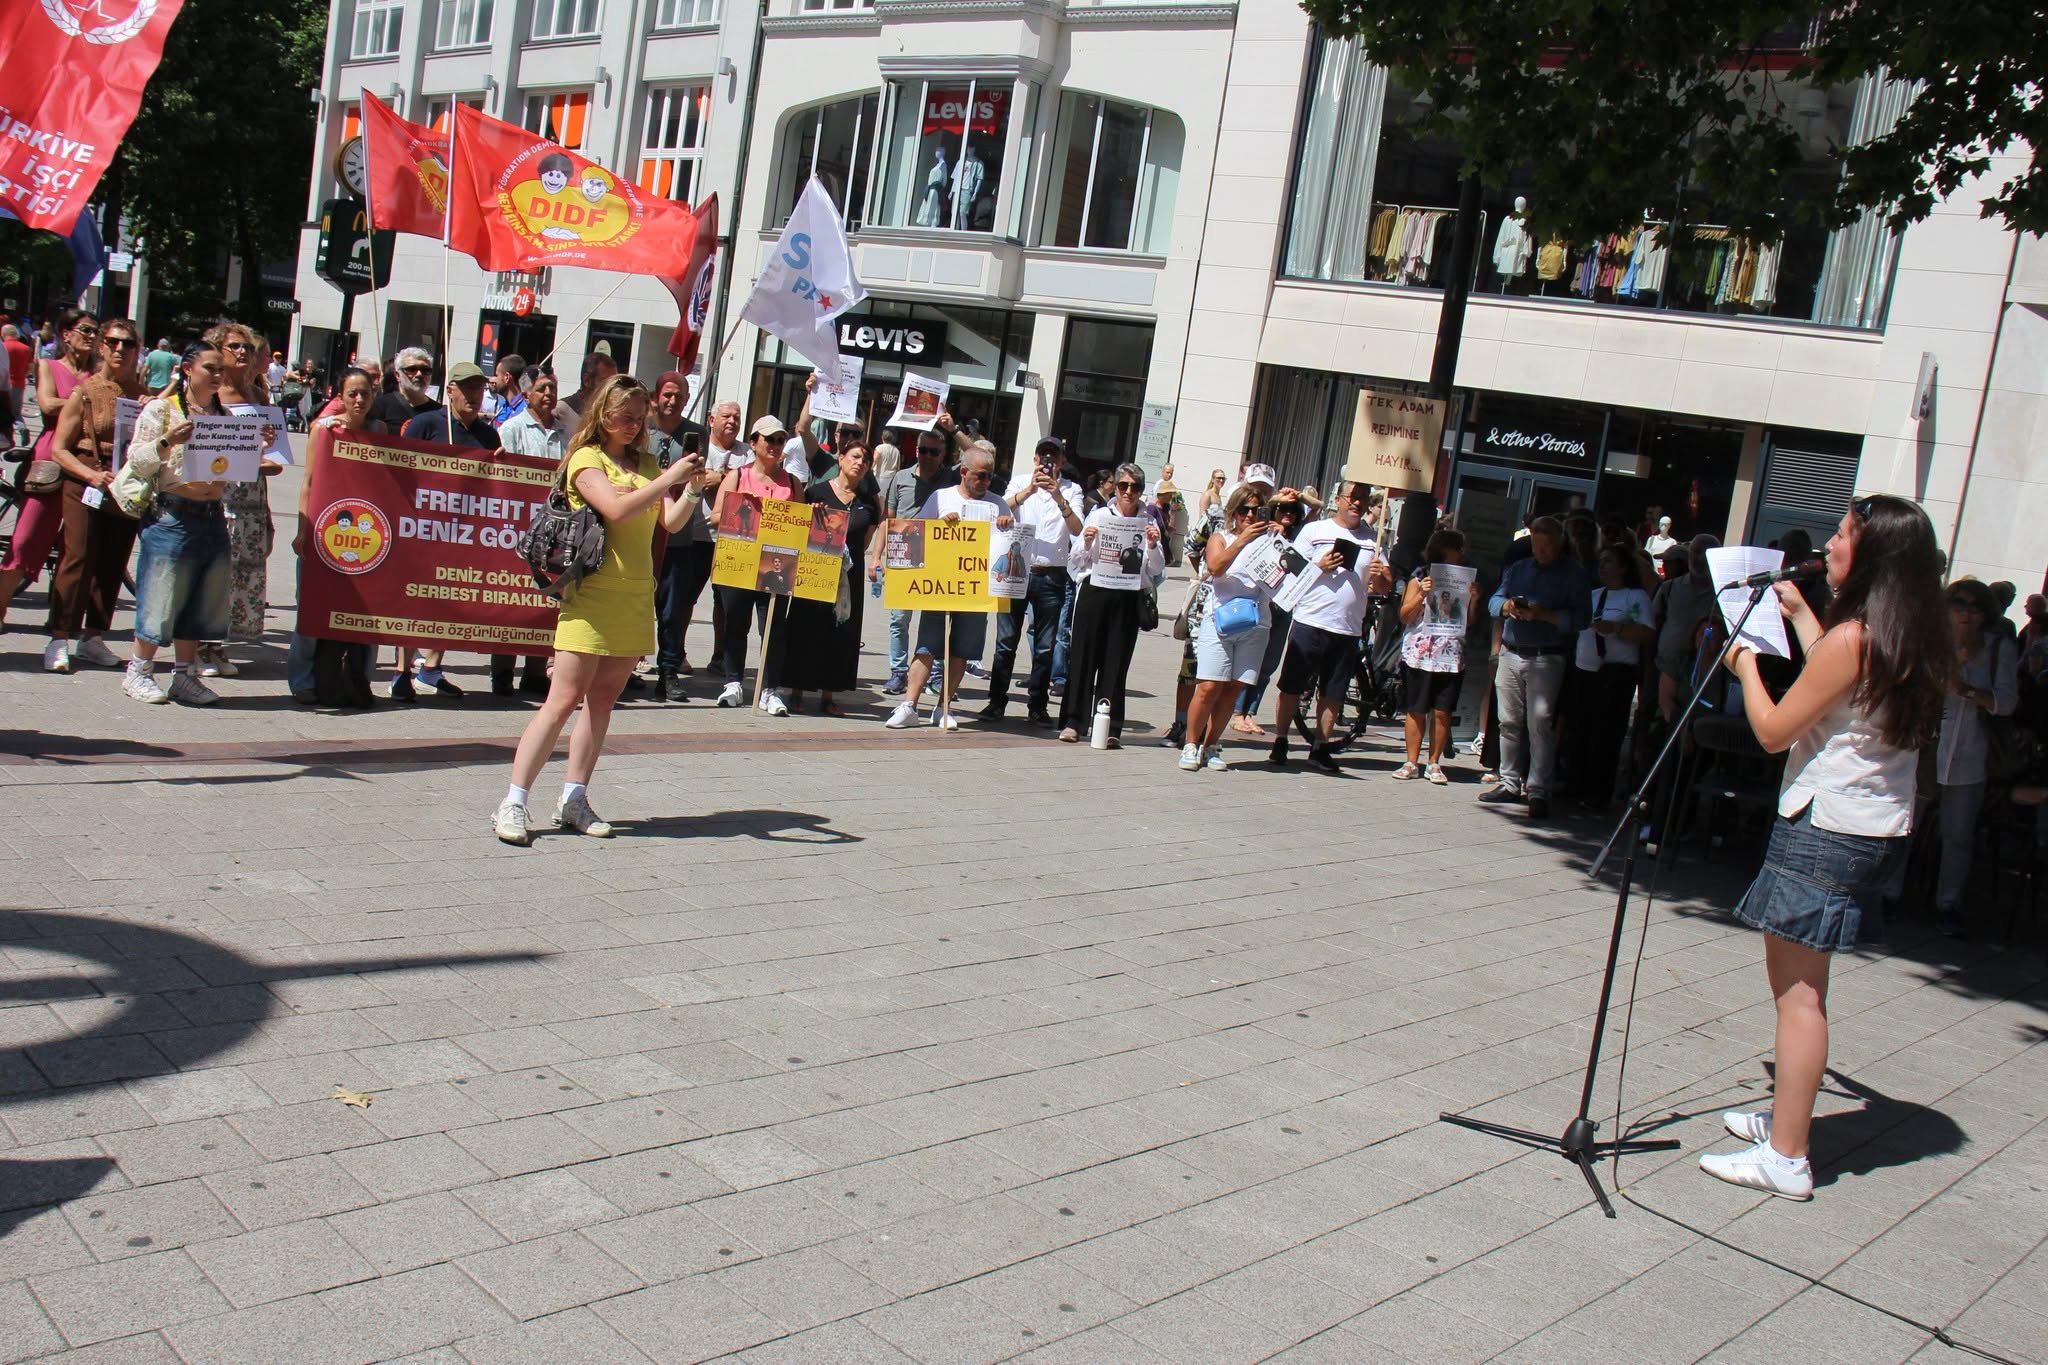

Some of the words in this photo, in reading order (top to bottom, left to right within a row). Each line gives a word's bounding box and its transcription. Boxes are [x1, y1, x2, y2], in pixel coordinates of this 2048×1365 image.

[0, 105, 95, 164] ÜRKİYE
[498, 149, 532, 191] FÖDERATION
[0, 176, 67, 216] RTİSİ
[498, 192, 544, 250] GEMEINSAM
[546, 241, 576, 252] SIND
[529, 196, 608, 228] DIDF
[782, 232, 811, 270] S
[348, 262, 362, 270] 200
[267, 300, 294, 310] CHRIST
[1367, 396, 1393, 408] TEK
[1399, 400, 1434, 415] ADAM
[196, 422, 222, 430] Finger
[188, 444, 258, 452] Meinungsfreiheit!
[1486, 427, 1500, 446] &
[1500, 429, 1540, 448] other
[1538, 433, 1586, 457] Stories
[338, 442, 385, 462] Finger
[389, 450, 416, 468] weg
[422, 456, 447, 468] von
[450, 460, 475, 473] der
[478, 463, 524, 479] Kunst-
[526, 470, 552, 482] und
[416, 488, 524, 520] FREIHEIT
[334, 534, 372, 549] DIDF
[399, 517, 474, 545] DENİZ
[480, 524, 525, 550] GÖ
[1102, 534, 1118, 542] DENİZ
[436, 565, 483, 584] DENİZ
[486, 568, 552, 588] GÖKTA
[714, 560, 754, 572] ADALET
[406, 583, 479, 603] SERBEST
[908, 579, 980, 595] ADALET
[334, 614, 381, 630] Sanat
[385, 621, 403, 632] ve
[408, 621, 444, 634] ifade
[448, 624, 549, 642] özgürlüğünden
